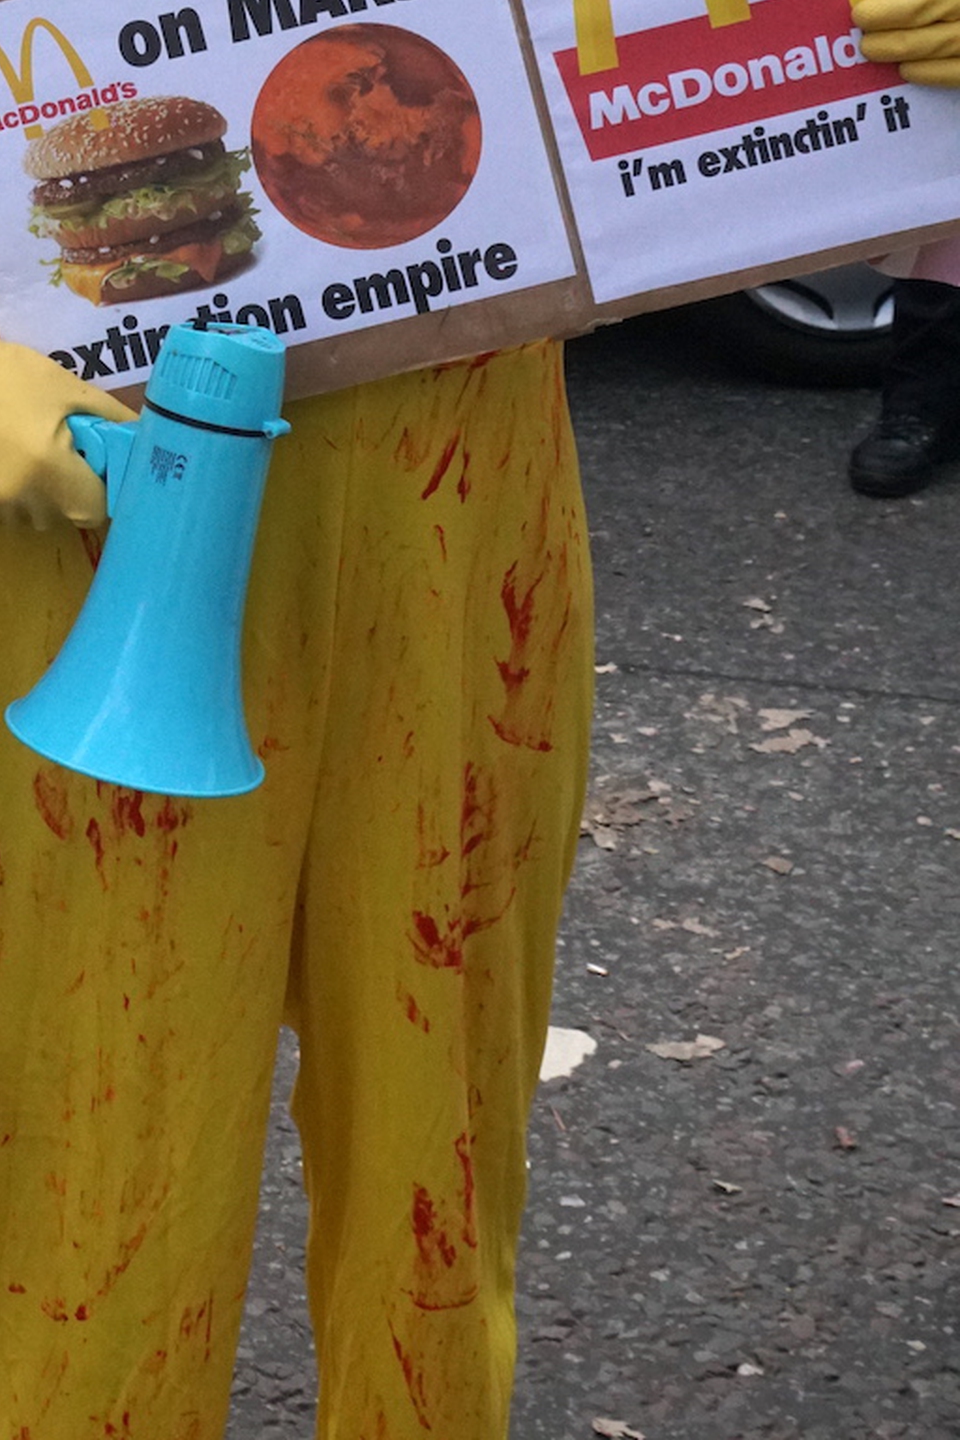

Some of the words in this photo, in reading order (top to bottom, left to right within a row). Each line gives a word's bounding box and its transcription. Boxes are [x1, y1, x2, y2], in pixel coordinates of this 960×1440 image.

[118, 7, 207, 68] on
[617, 157, 687, 197] i'm
[697, 102, 868, 178] extinctin'
[880, 94, 912, 133] it
[321, 238, 519, 320] empire
